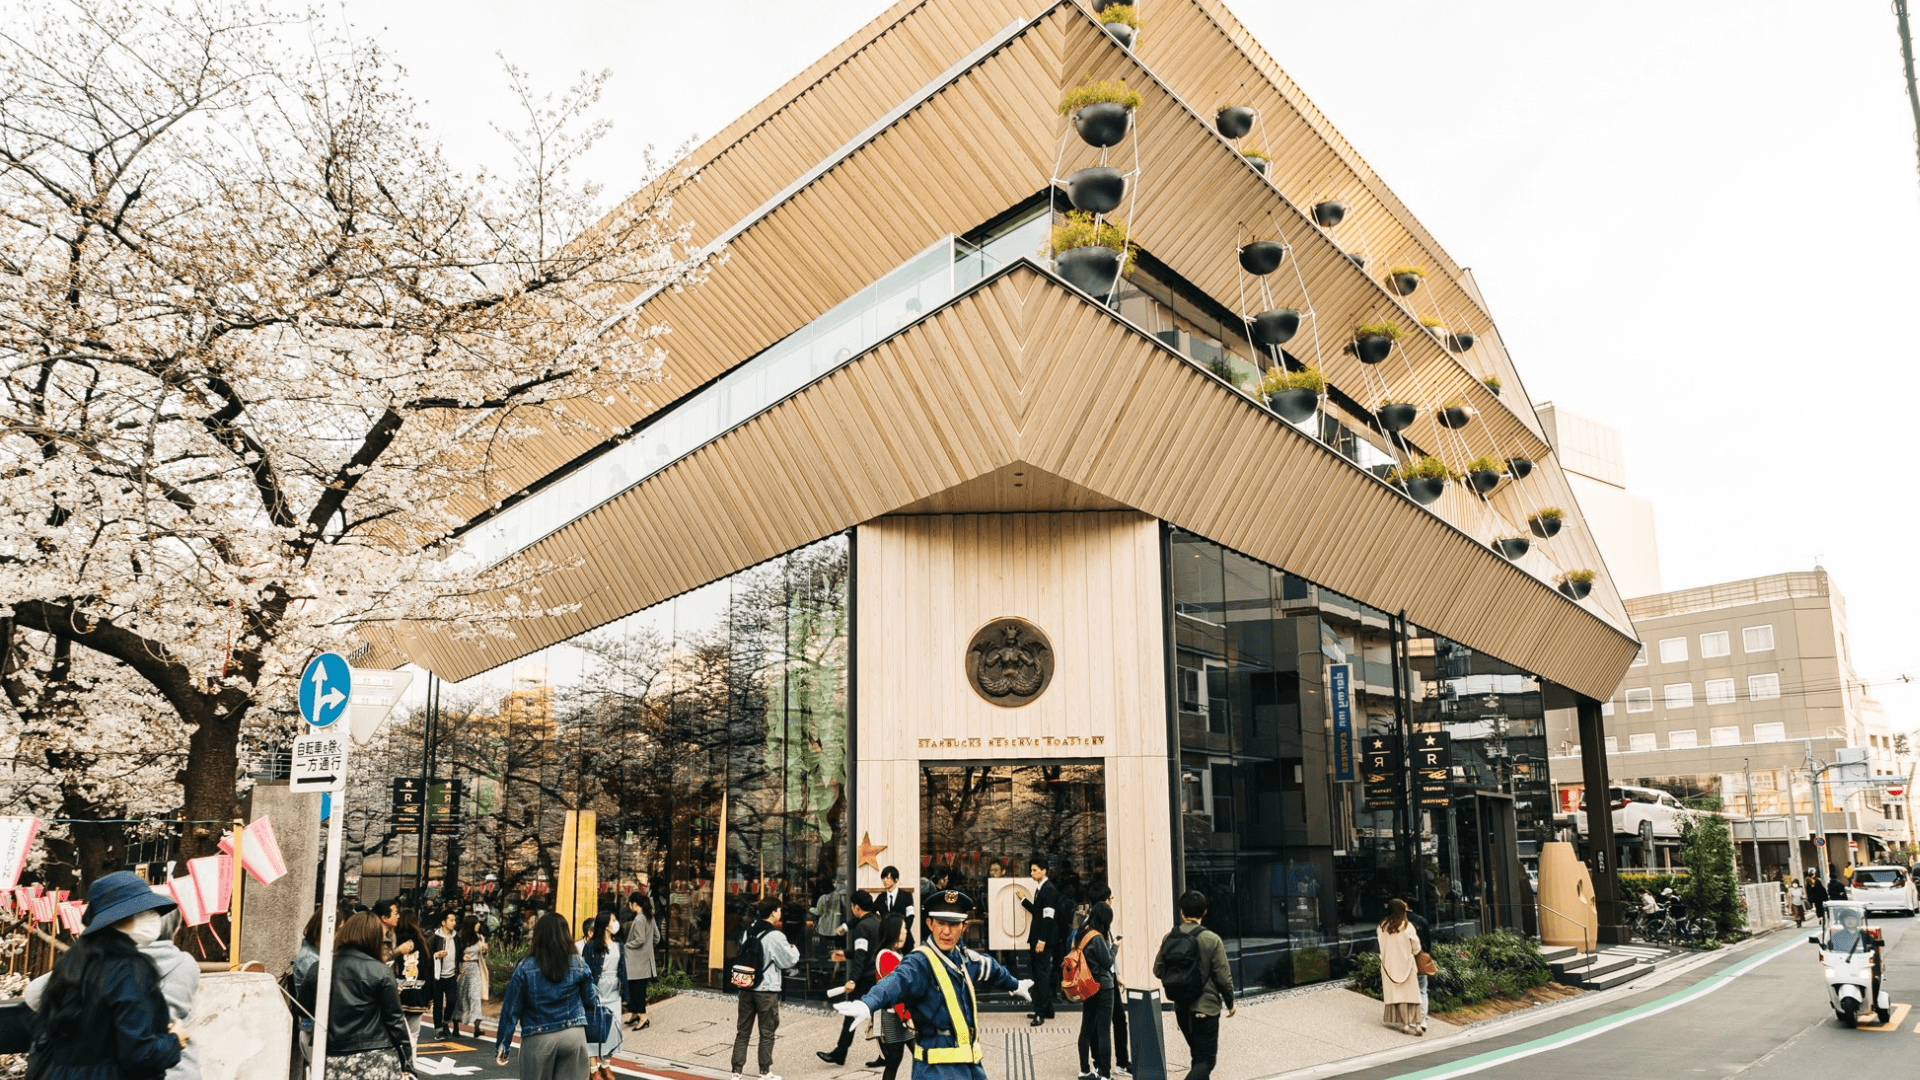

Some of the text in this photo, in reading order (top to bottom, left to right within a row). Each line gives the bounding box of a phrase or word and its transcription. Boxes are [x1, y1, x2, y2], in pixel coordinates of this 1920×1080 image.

[297, 740, 342, 756] 自転車を除く
[918, 737, 1104, 748] STARBUCKS RESERVE ROASTERY
[296, 756, 341, 772] 一方通行
[1427, 753, 1437, 765] R
[404, 793, 412, 802] R
